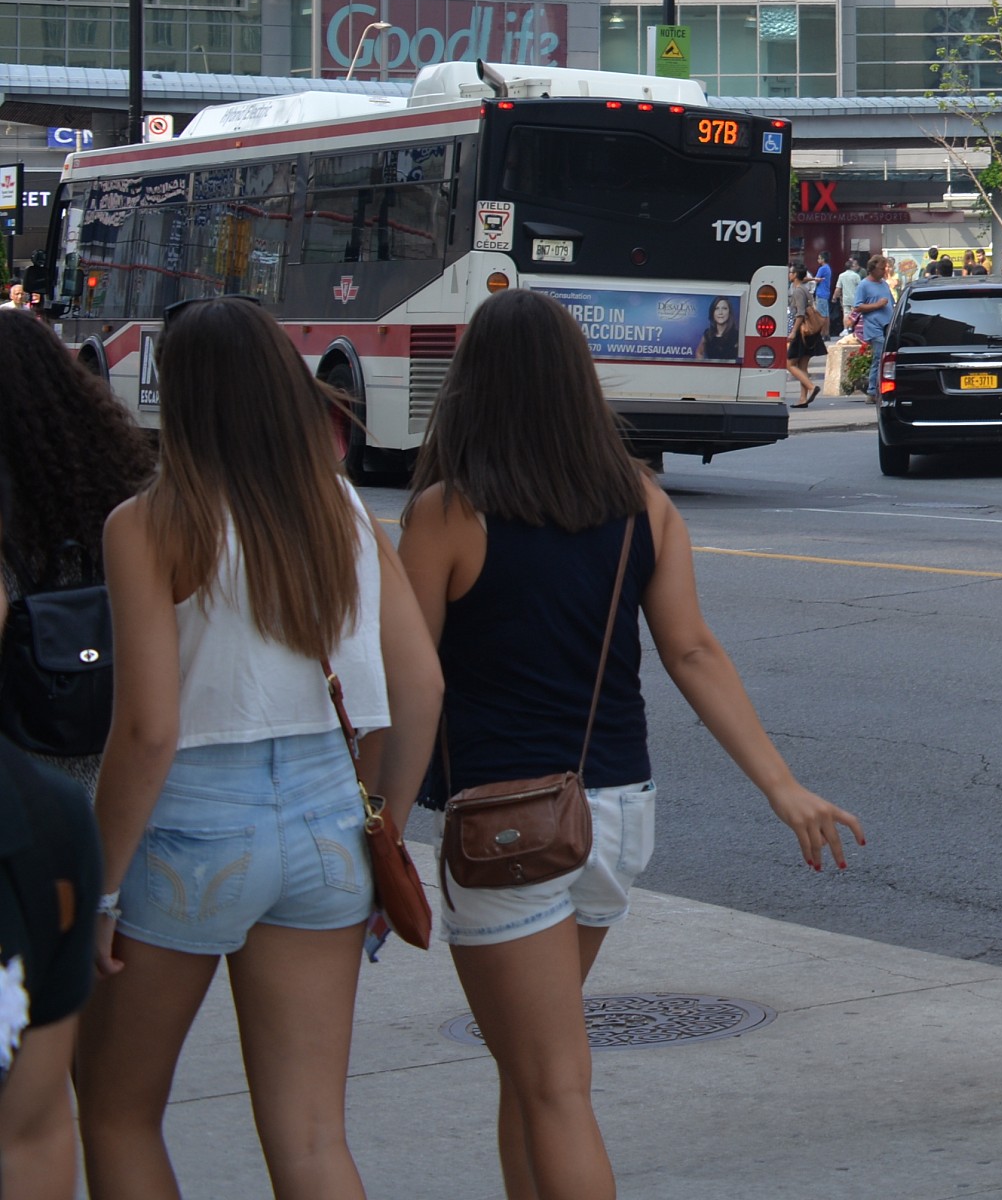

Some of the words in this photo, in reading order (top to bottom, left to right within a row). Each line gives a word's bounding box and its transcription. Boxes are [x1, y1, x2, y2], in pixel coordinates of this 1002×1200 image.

[660, 29, 686, 38] NOTICE
[698, 119, 739, 145] 97B
[480, 202, 511, 211] YIELD
[711, 220, 762, 243] 1791
[550, 291, 592, 301] Consultation
[564, 304, 605, 323] URED
[609, 309, 625, 323] IN
[582, 324, 663, 342] ACCIDENT?
[607, 344, 693, 356] WWW.DESAILAW.CA
[964, 375, 994, 386] GRE-3711
